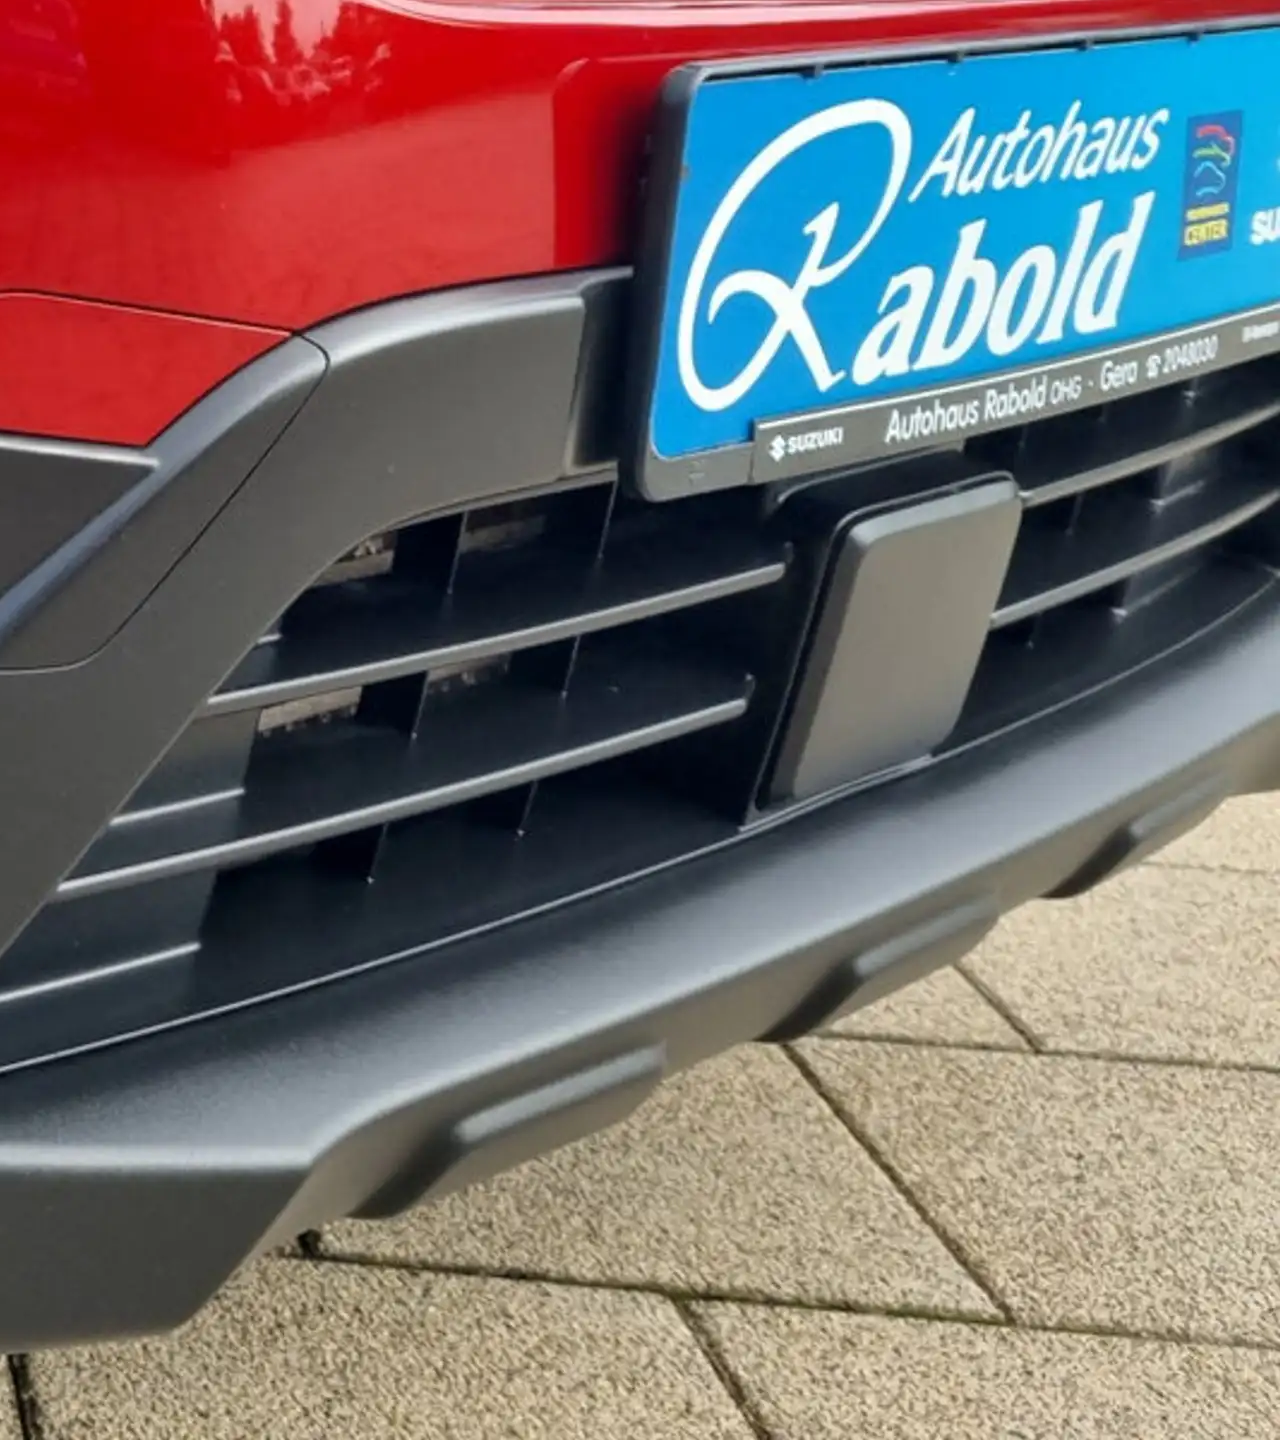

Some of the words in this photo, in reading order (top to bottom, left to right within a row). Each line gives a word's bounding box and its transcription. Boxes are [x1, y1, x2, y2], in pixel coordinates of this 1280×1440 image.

[907, 99, 1171, 204] Autohaus
[677, 98, 1156, 413] Rabold
[787, 426, 844, 455] SUZUKI
[884, 398, 981, 444] Autohaus
[983, 375, 1048, 421] Rabold
[1050, 376, 1082, 405] OHG
